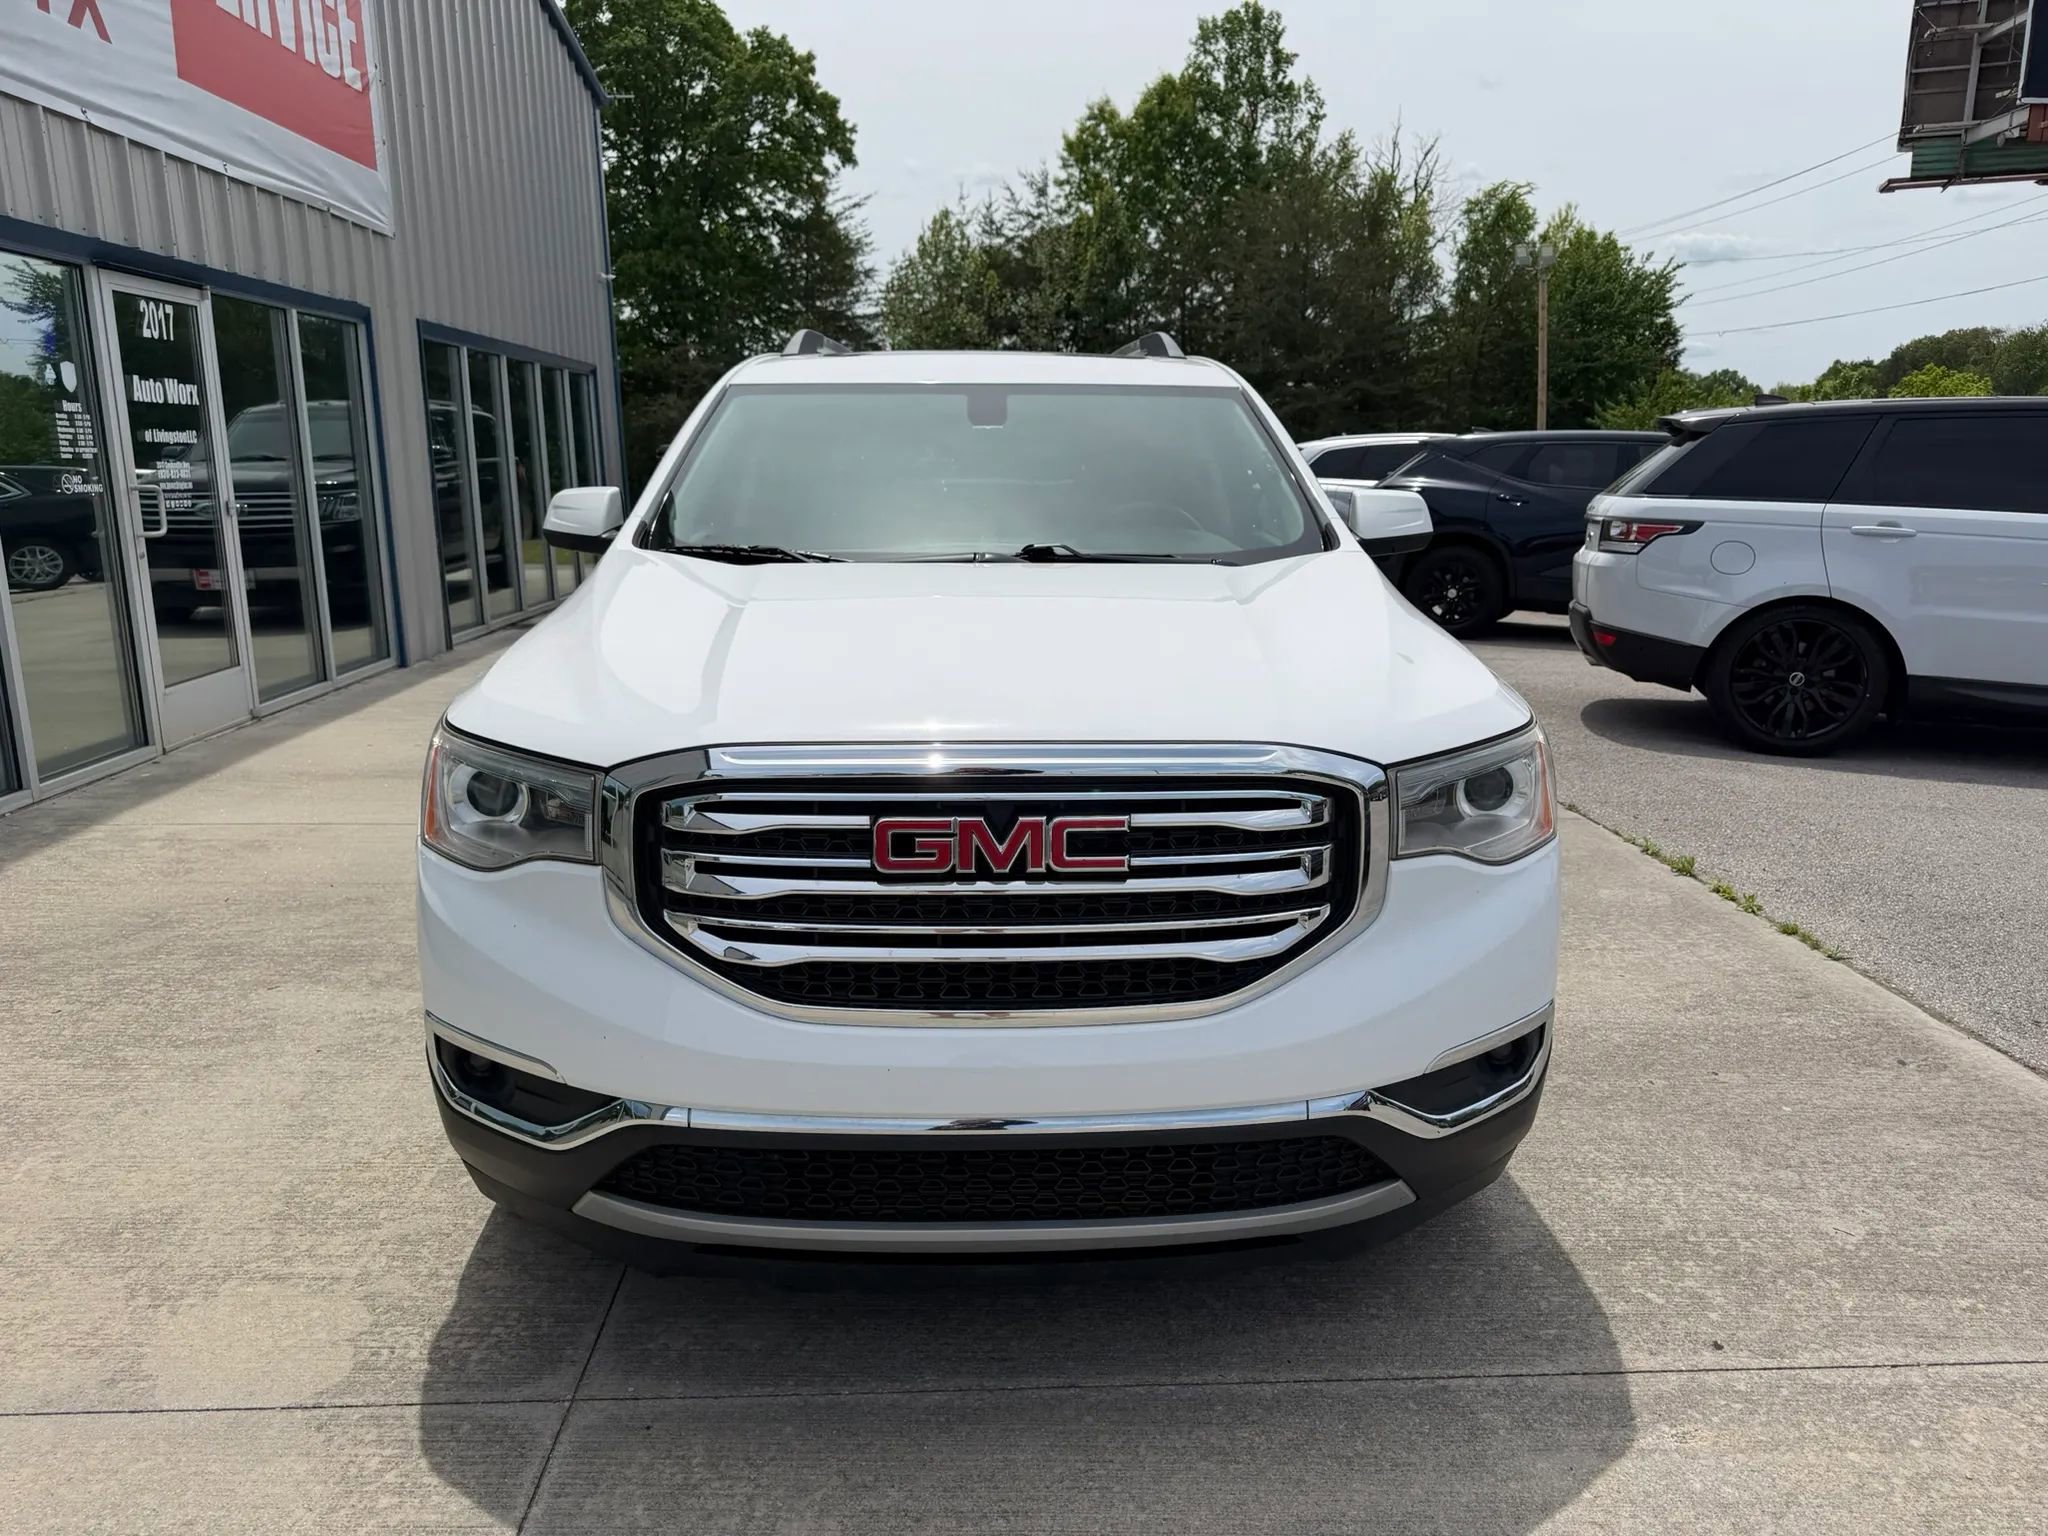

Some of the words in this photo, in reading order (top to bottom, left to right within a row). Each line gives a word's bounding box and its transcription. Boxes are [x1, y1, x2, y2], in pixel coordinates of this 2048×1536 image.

[140, 299, 174, 341] 2017
[132, 374, 165, 404] Auto
[164, 377, 200, 406] Worx
[62, 399, 83, 413] Hours
[144, 428, 153, 443] of
[72, 475, 83, 484] NO
[74, 483, 104, 494] SMOKING
[873, 815, 1131, 874] GMC
